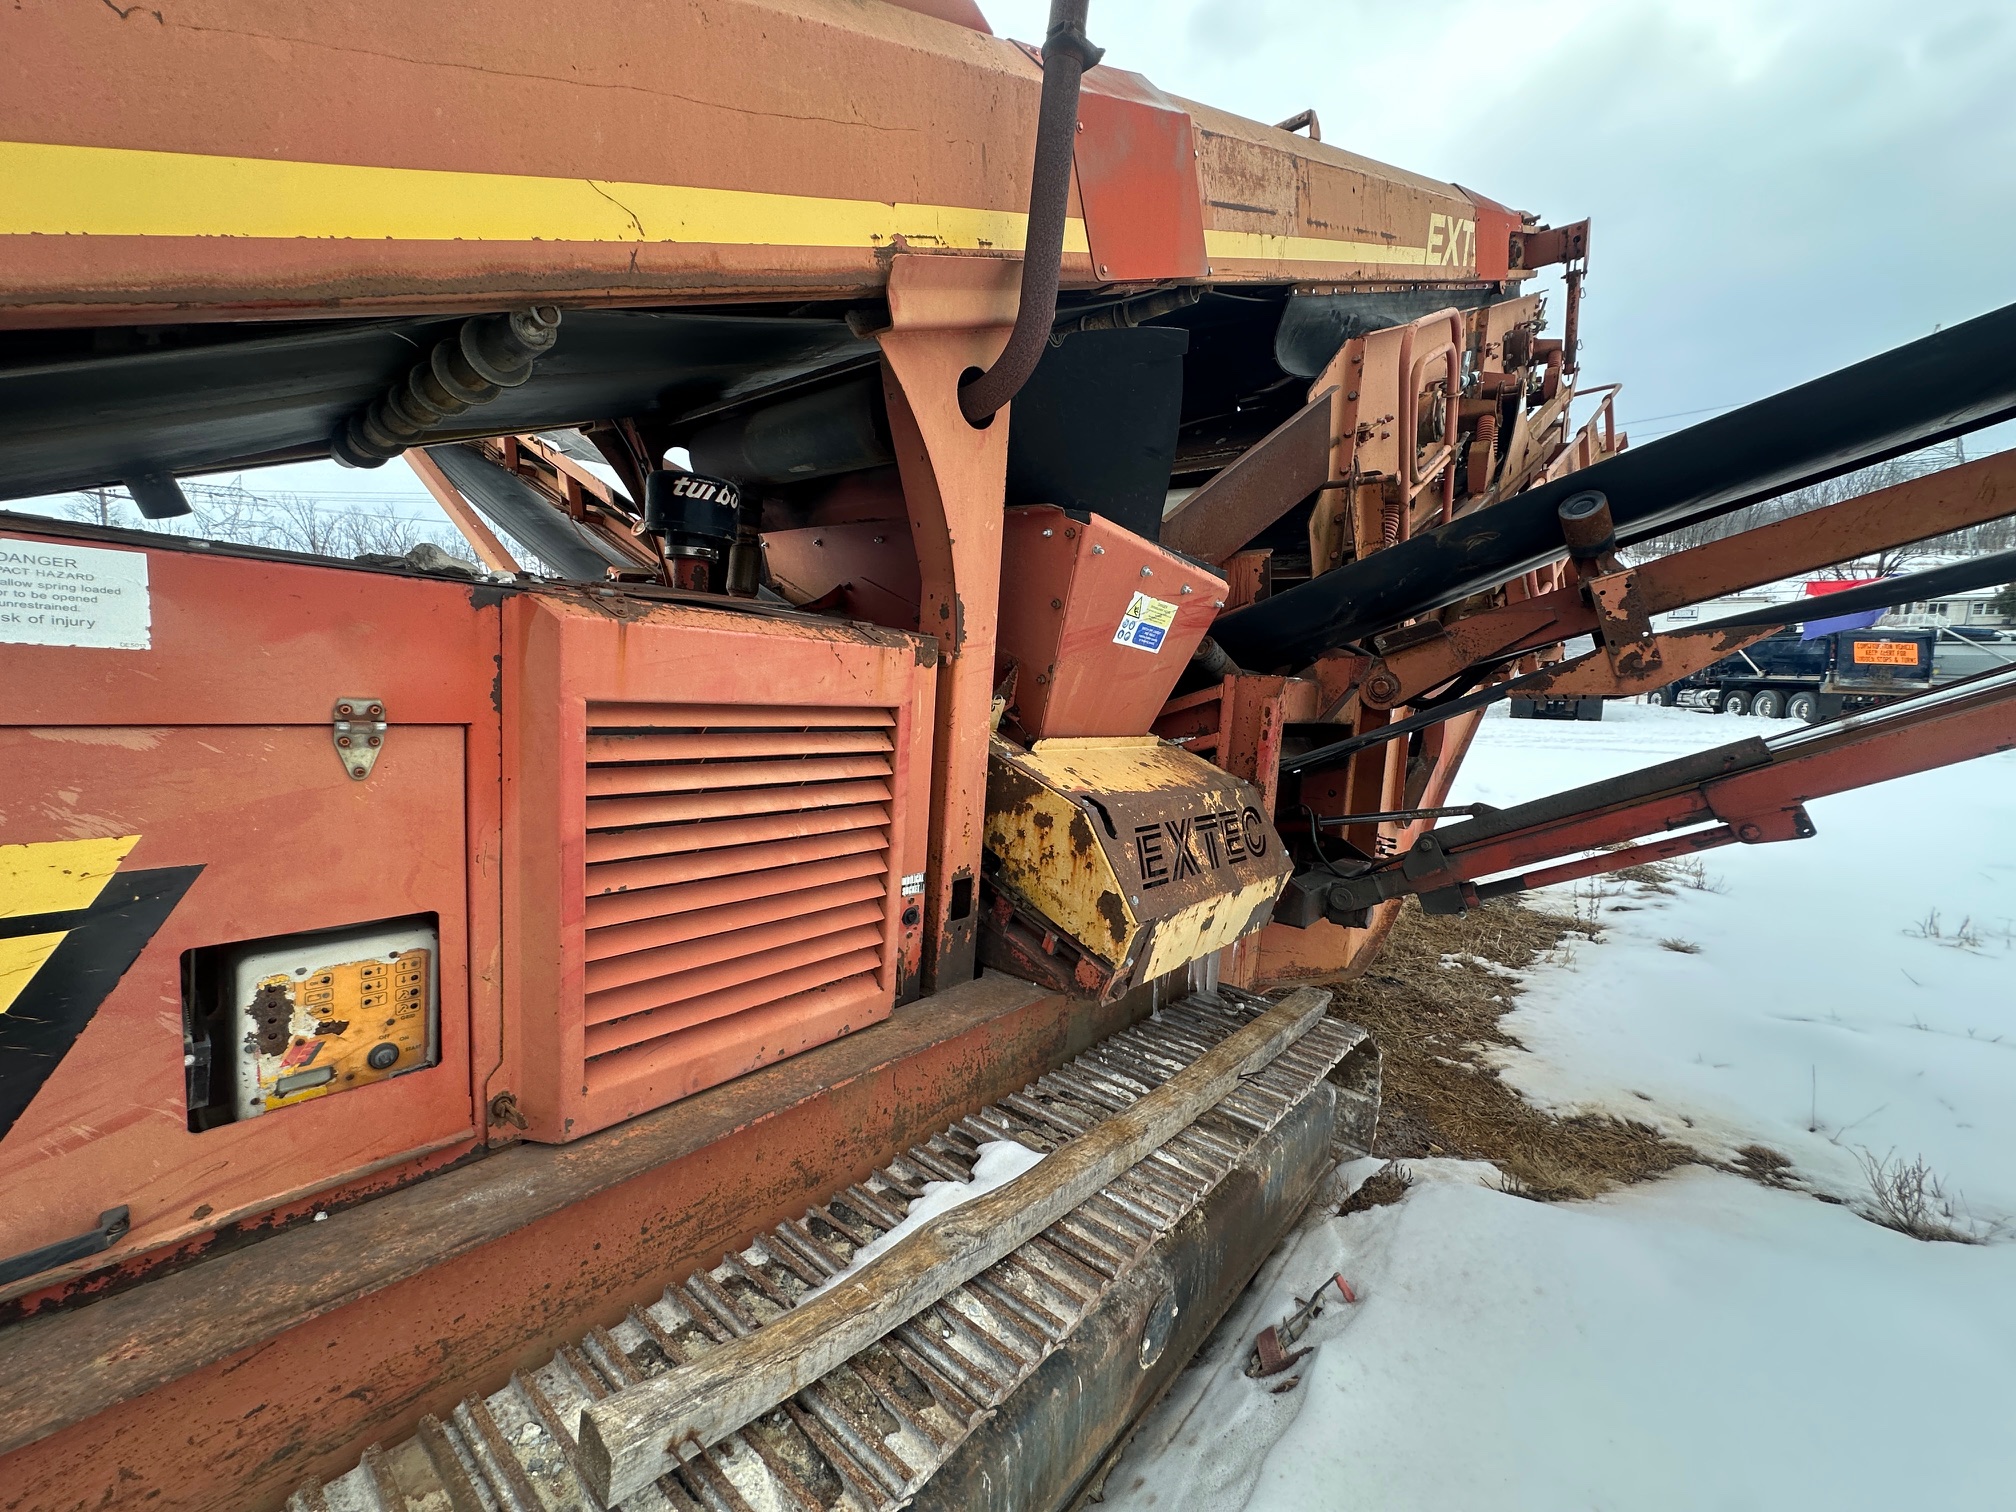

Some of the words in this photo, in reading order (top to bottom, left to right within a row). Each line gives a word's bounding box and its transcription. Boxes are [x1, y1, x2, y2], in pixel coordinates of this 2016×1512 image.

[1426, 213, 1475, 267] EXT
[673, 477, 738, 509] turbo
[36, 569, 95, 581] HAZARD
[0, 578, 33, 588] allow
[38, 582, 76, 593] spring
[81, 585, 122, 595] loaded
[31, 591, 47, 599] be
[52, 594, 98, 603] opened
[28, 614, 45, 624] of
[51, 615, 96, 629] injury
[1135, 806, 1267, 890] EXTEC
